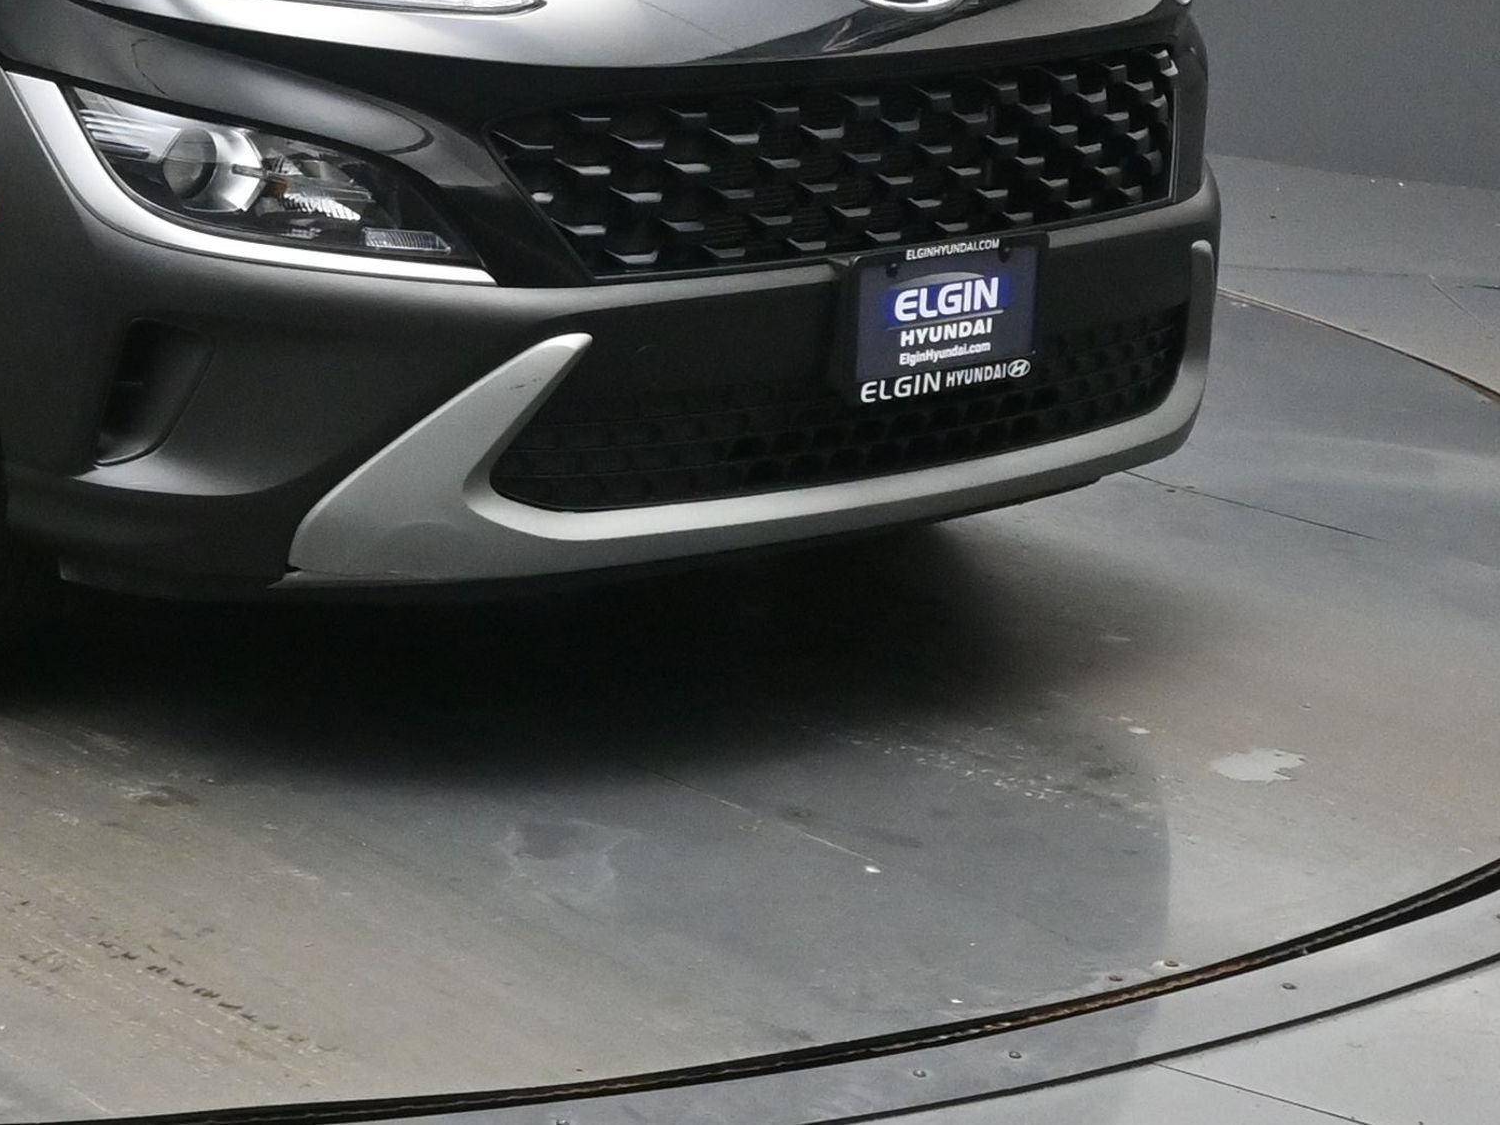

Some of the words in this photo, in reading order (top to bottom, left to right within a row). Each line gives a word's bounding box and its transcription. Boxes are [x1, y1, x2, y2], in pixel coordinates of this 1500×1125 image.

[905, 238, 1000, 261] ELGINHYUNDAI.COM
[894, 277, 999, 322] ELGIN
[900, 317, 993, 347] HYUNDAI
[899, 341, 991, 367] ElginHyundai.com
[860, 371, 941, 403] ELGIN
[946, 362, 1006, 388] HYUNDAI
